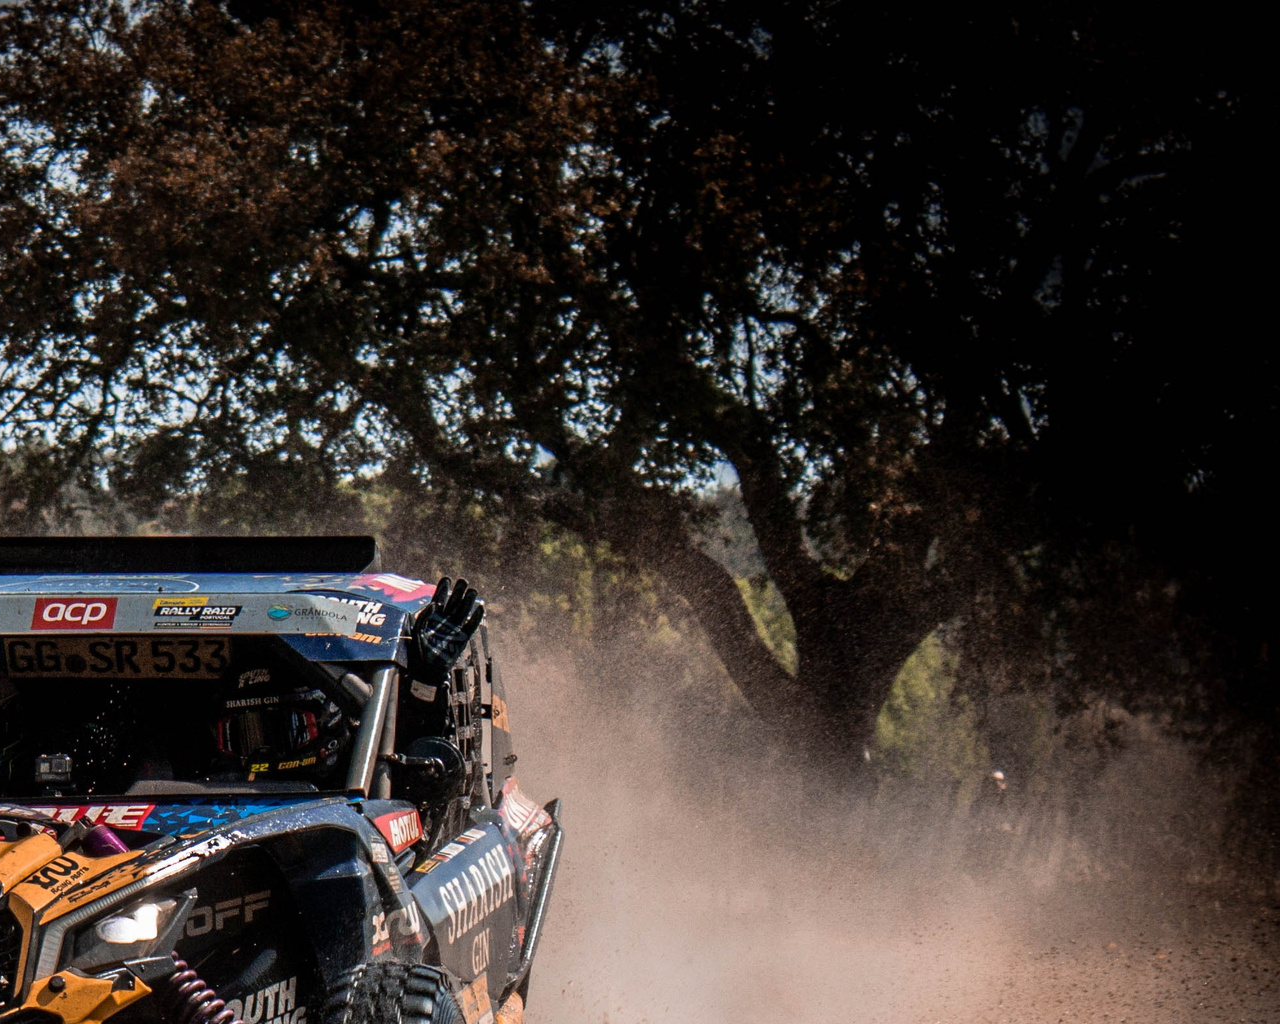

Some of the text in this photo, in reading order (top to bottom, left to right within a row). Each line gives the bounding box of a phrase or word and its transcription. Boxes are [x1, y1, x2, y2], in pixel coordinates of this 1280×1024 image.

[42, 602, 107, 625] acp
[160, 607, 236, 616] RALLY RAID
[8, 640, 226, 673] GG SR 533
[226, 696, 279, 709] SHARISH GIN
[251, 763, 269, 772] 22
[389, 811, 420, 847] MOTUL
[439, 843, 514, 945] SHARISH
[178, 889, 270, 940] OFF
[472, 927, 490, 976] GIN
